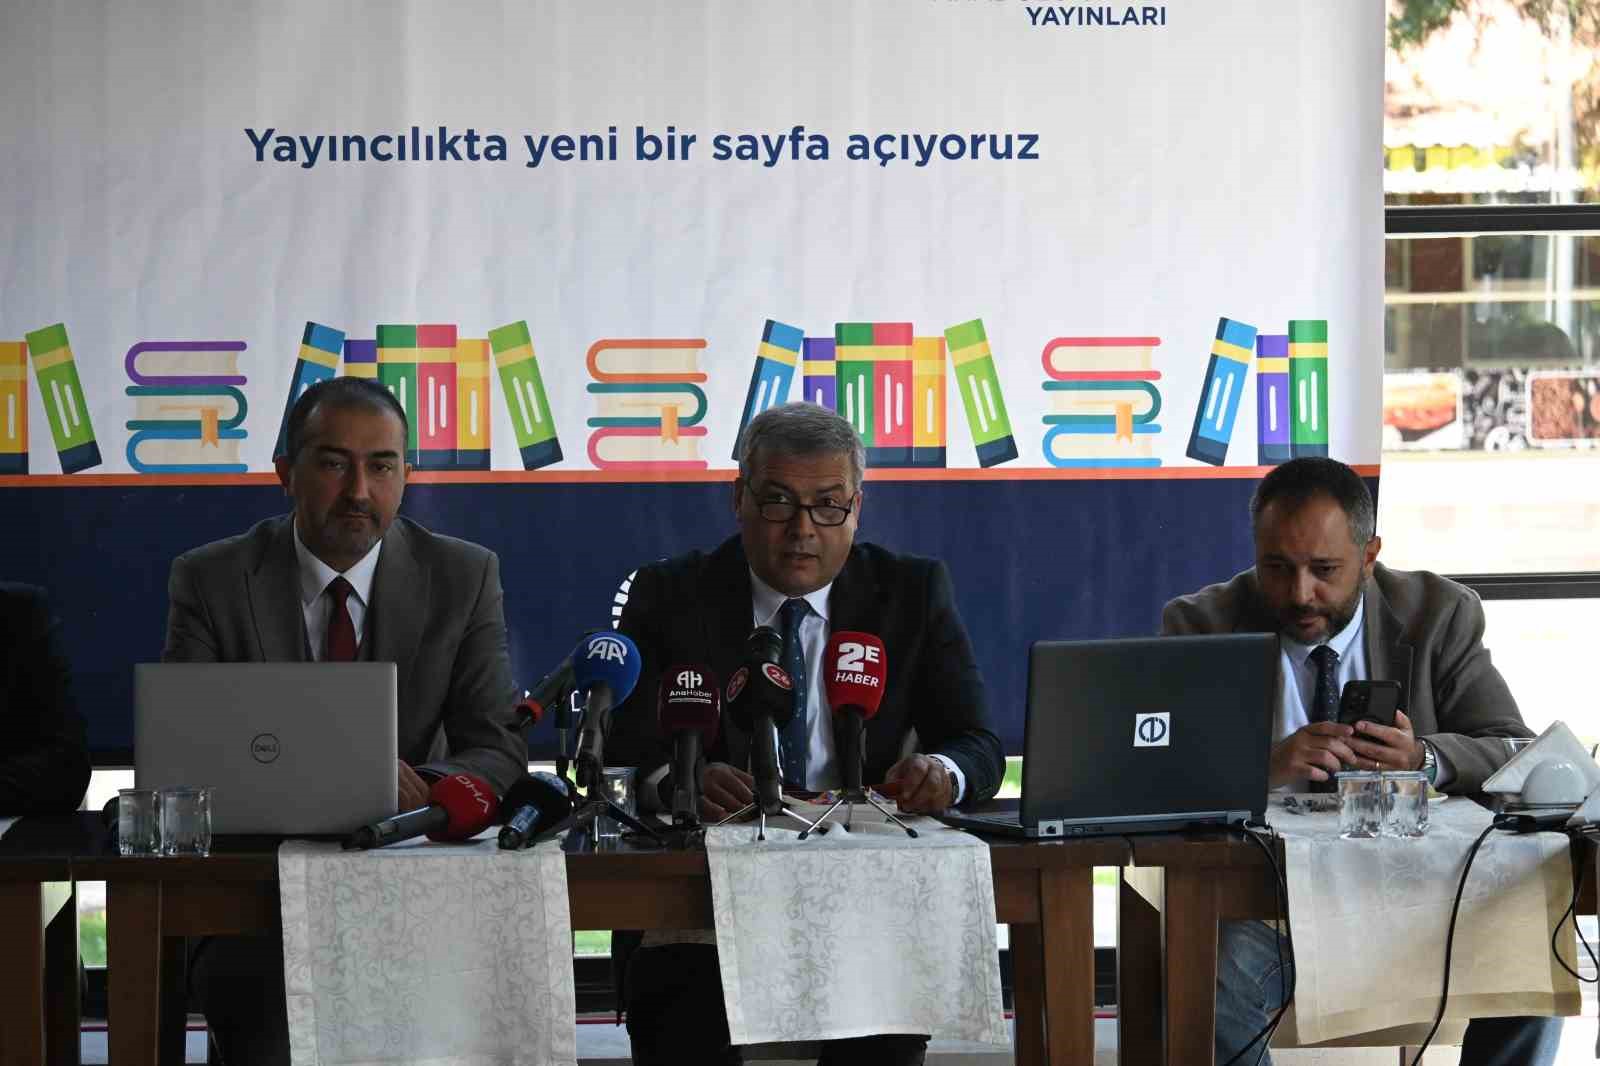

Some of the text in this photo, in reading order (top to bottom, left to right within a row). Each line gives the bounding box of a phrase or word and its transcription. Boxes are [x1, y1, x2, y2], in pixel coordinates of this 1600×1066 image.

[1025, 6, 1166, 26] YAYINLARI
[244, 126, 1040, 169] Yayıncılıkta yeni bir sayfa açıyoruz
[587, 636, 627, 665] AA
[835, 672, 880, 688] HABER
